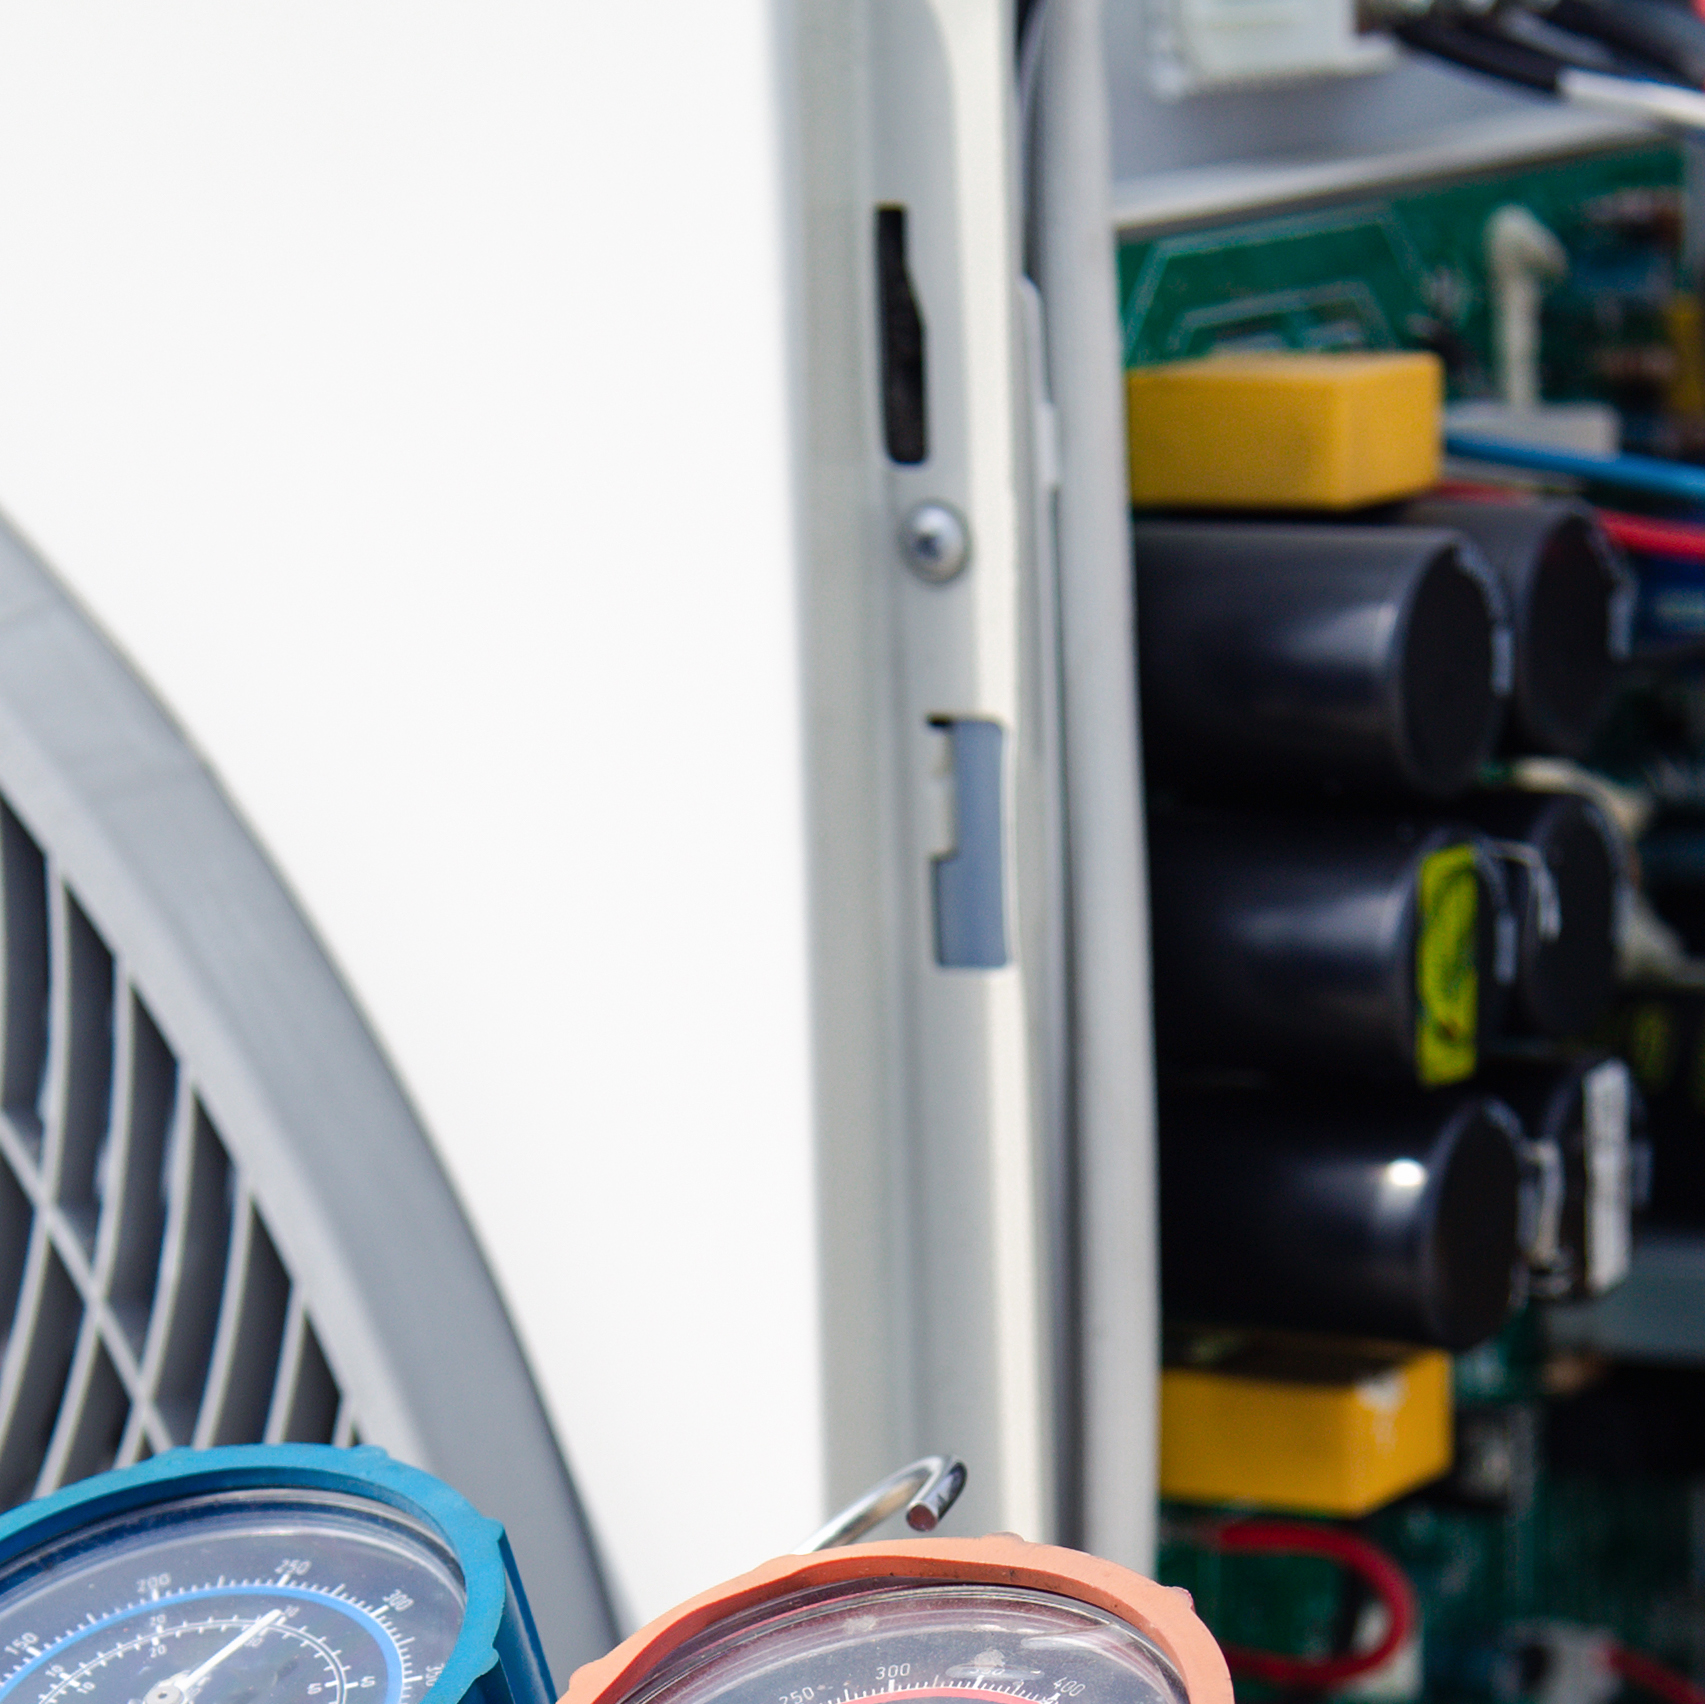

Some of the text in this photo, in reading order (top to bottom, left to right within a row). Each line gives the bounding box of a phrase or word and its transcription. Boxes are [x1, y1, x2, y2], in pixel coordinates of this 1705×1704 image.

[275, 1558, 311, 1575] 250
[137, 1572, 171, 1592] 200
[382, 1589, 414, 1611] 300
[150, 1613, 166, 1626] 20
[4, 1632, 38, 1655] 150
[150, 1644, 167, 1658] 20
[45, 1664, 64, 1677] 10
[875, 1662, 910, 1680] 300
[76, 1681, 94, 1694] 10
[1053, 1676, 1085, 1696] 400
